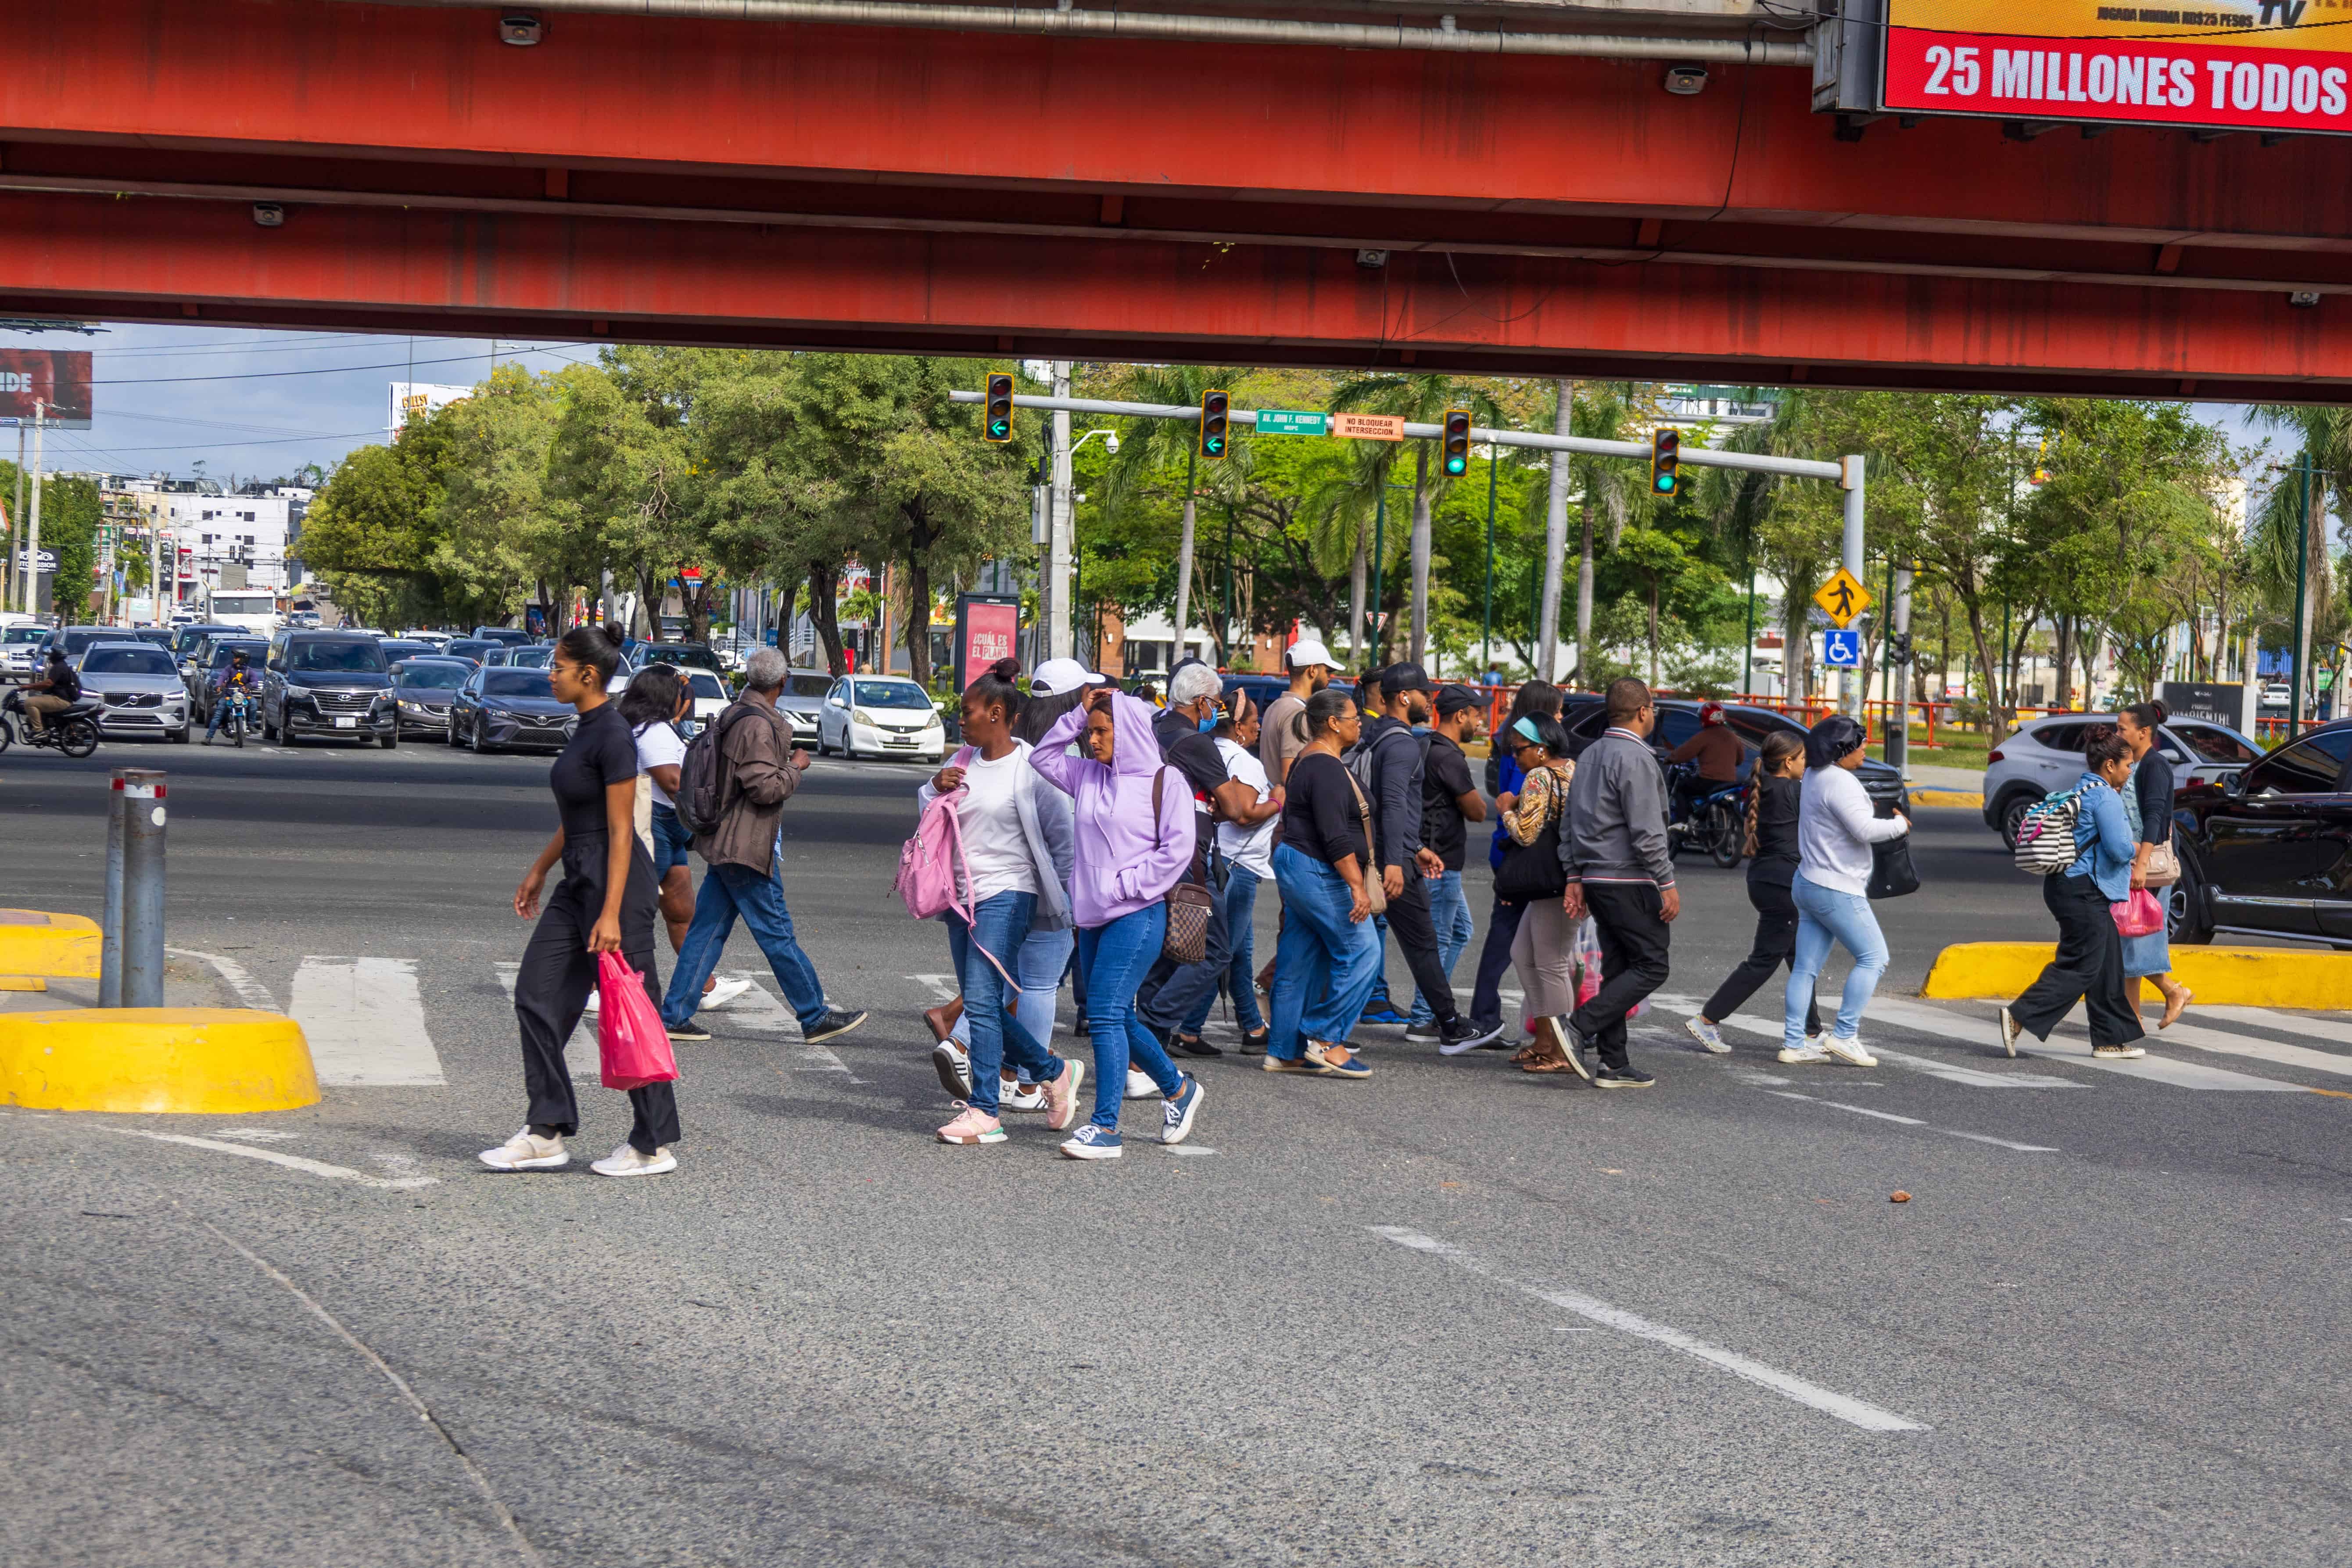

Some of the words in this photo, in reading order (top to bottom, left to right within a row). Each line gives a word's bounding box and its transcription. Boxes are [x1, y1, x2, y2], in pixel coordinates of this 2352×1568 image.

[2258, 0, 2306, 26] TV
[1924, 46, 1981, 95] 25
[1991, 48, 2195, 107] MILLONES
[2206, 60, 2348, 115] TODOS
[1262, 413, 1271, 422] AV.
[1273, 414, 1288, 423] JOHN
[1289, 415, 1294, 423] F.
[1295, 415, 1321, 424] KENNEDY
[1358, 419, 1393, 427] BLOQUEAR
[1345, 426, 1393, 435] INTERSECCION
[973, 631, 996, 646] ¿CUÁL
[998, 635, 1008, 646] ES
[972, 646, 981, 658] EL
[983, 646, 1007, 659] PLAN?
